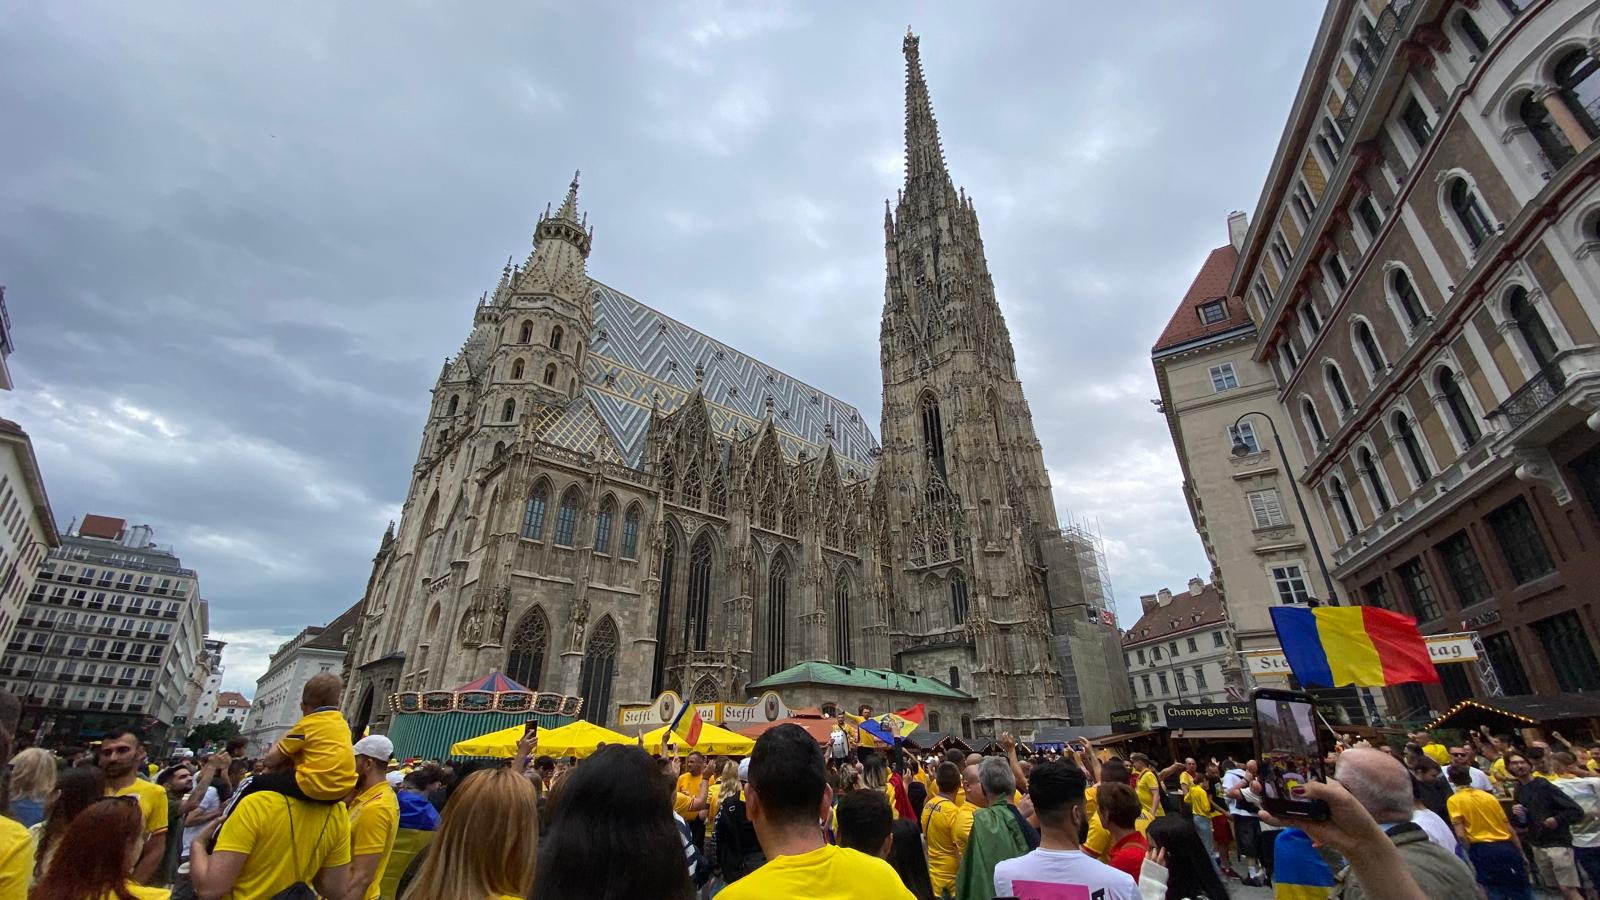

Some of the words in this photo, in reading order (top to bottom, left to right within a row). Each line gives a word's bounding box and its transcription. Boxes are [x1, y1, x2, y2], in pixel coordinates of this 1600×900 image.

[1261, 656, 1289, 669] Ste
[1429, 645, 1462, 658] tag
[625, 710, 650, 724] Steffl
[726, 706, 754, 721] Steffl
[1167, 706, 1229, 717] Champagner
[1231, 705, 1249, 715] Bar
